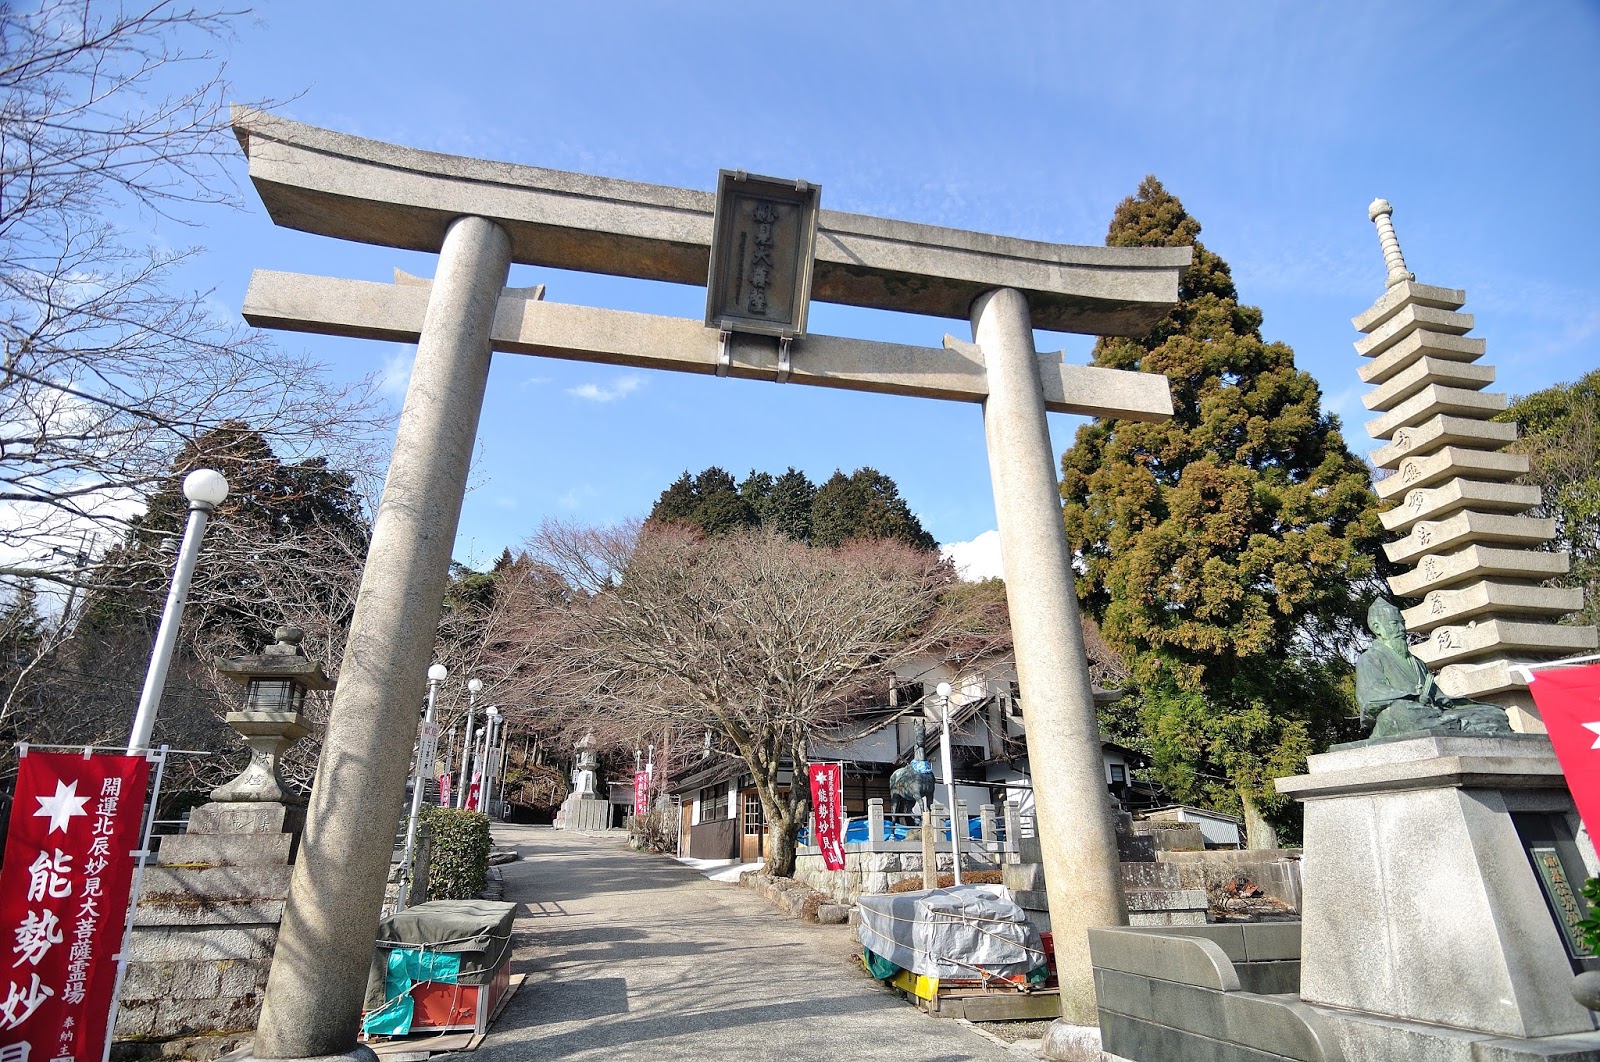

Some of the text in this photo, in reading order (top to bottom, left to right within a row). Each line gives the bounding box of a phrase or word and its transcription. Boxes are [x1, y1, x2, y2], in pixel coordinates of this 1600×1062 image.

[61, 777, 122, 1005] 開運北辰妙見大菩薩霊場
[57, 1016, 75, 1057] 奉納主
